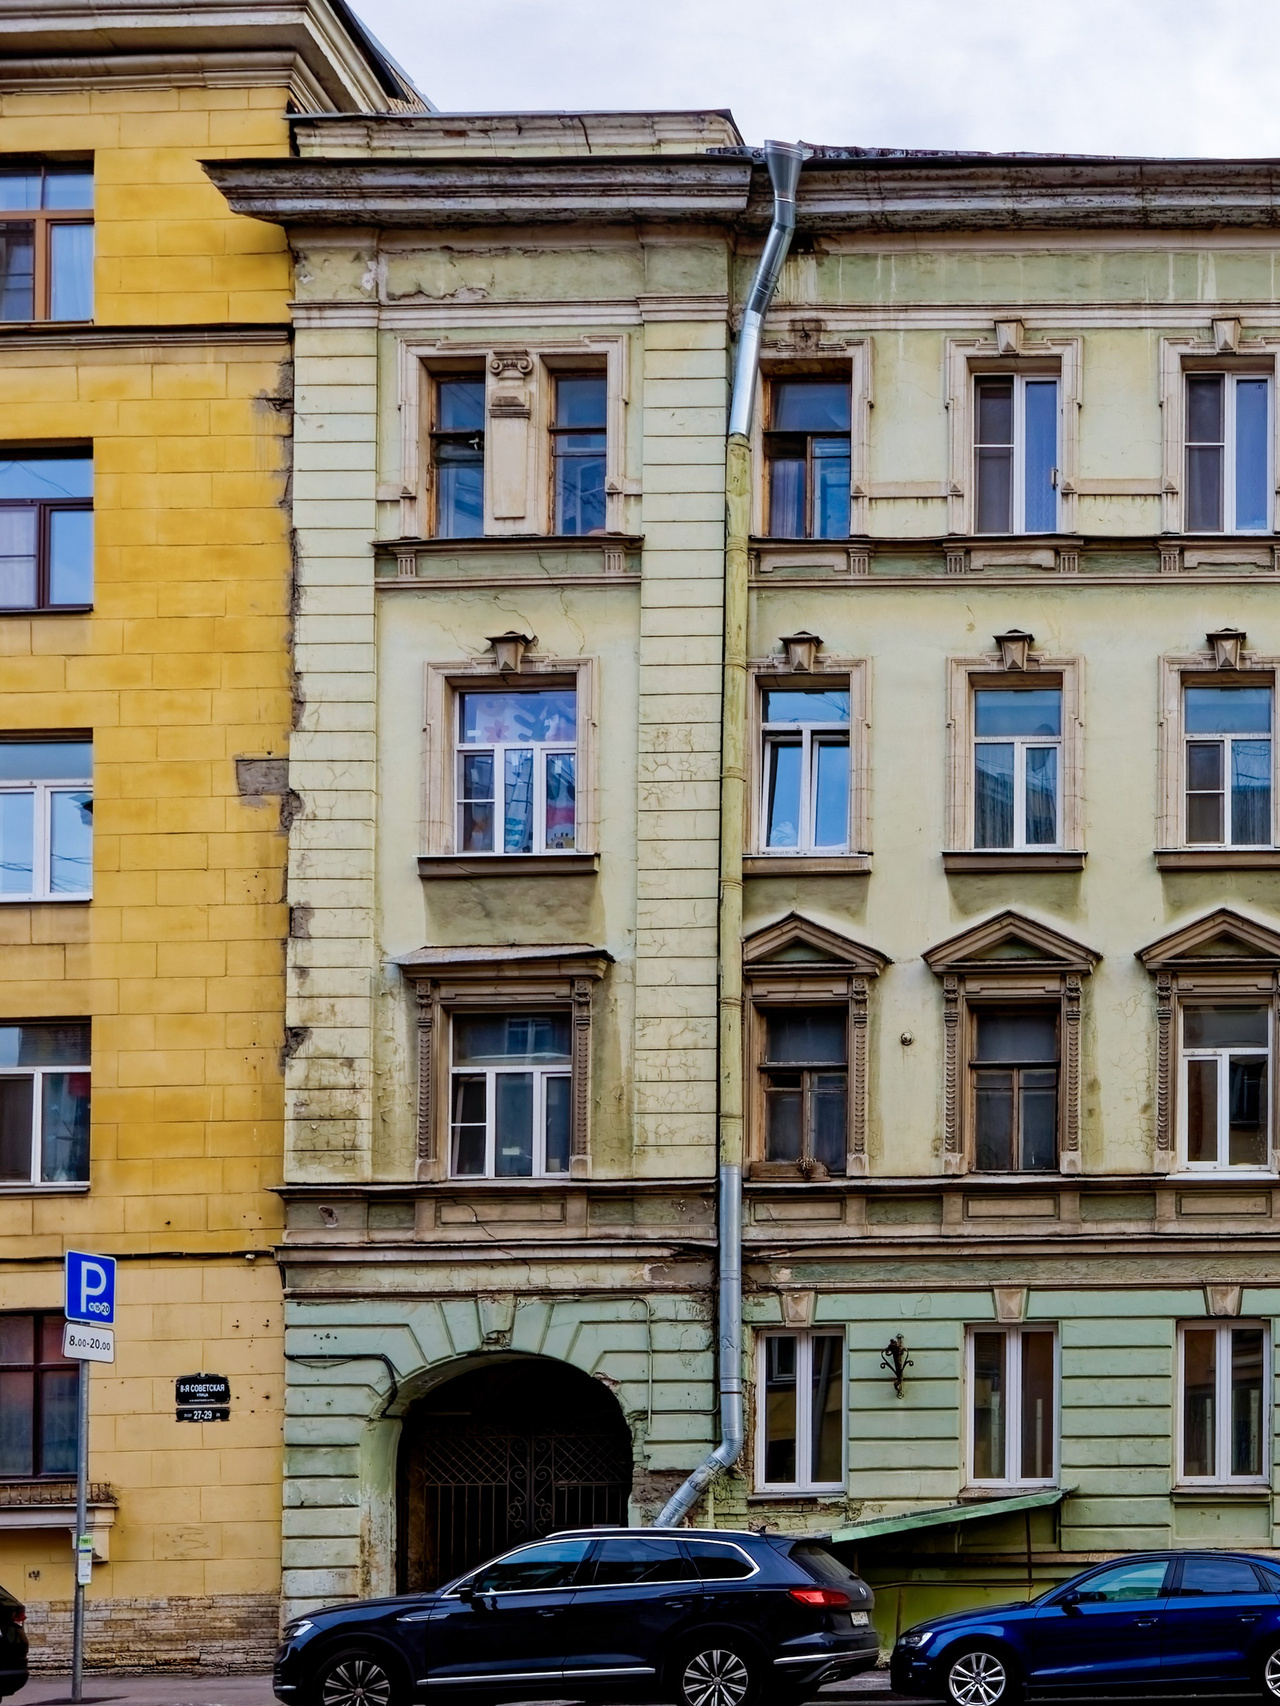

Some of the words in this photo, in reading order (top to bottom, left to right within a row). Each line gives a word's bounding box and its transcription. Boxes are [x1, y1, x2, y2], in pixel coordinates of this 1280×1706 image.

[81, 1261, 107, 1313] P
[69, 1335, 111, 1351] 8.00-20.00
[190, 1384, 225, 1392] СОВЕТСКАЯ
[193, 1410, 212, 1419] 27-29
